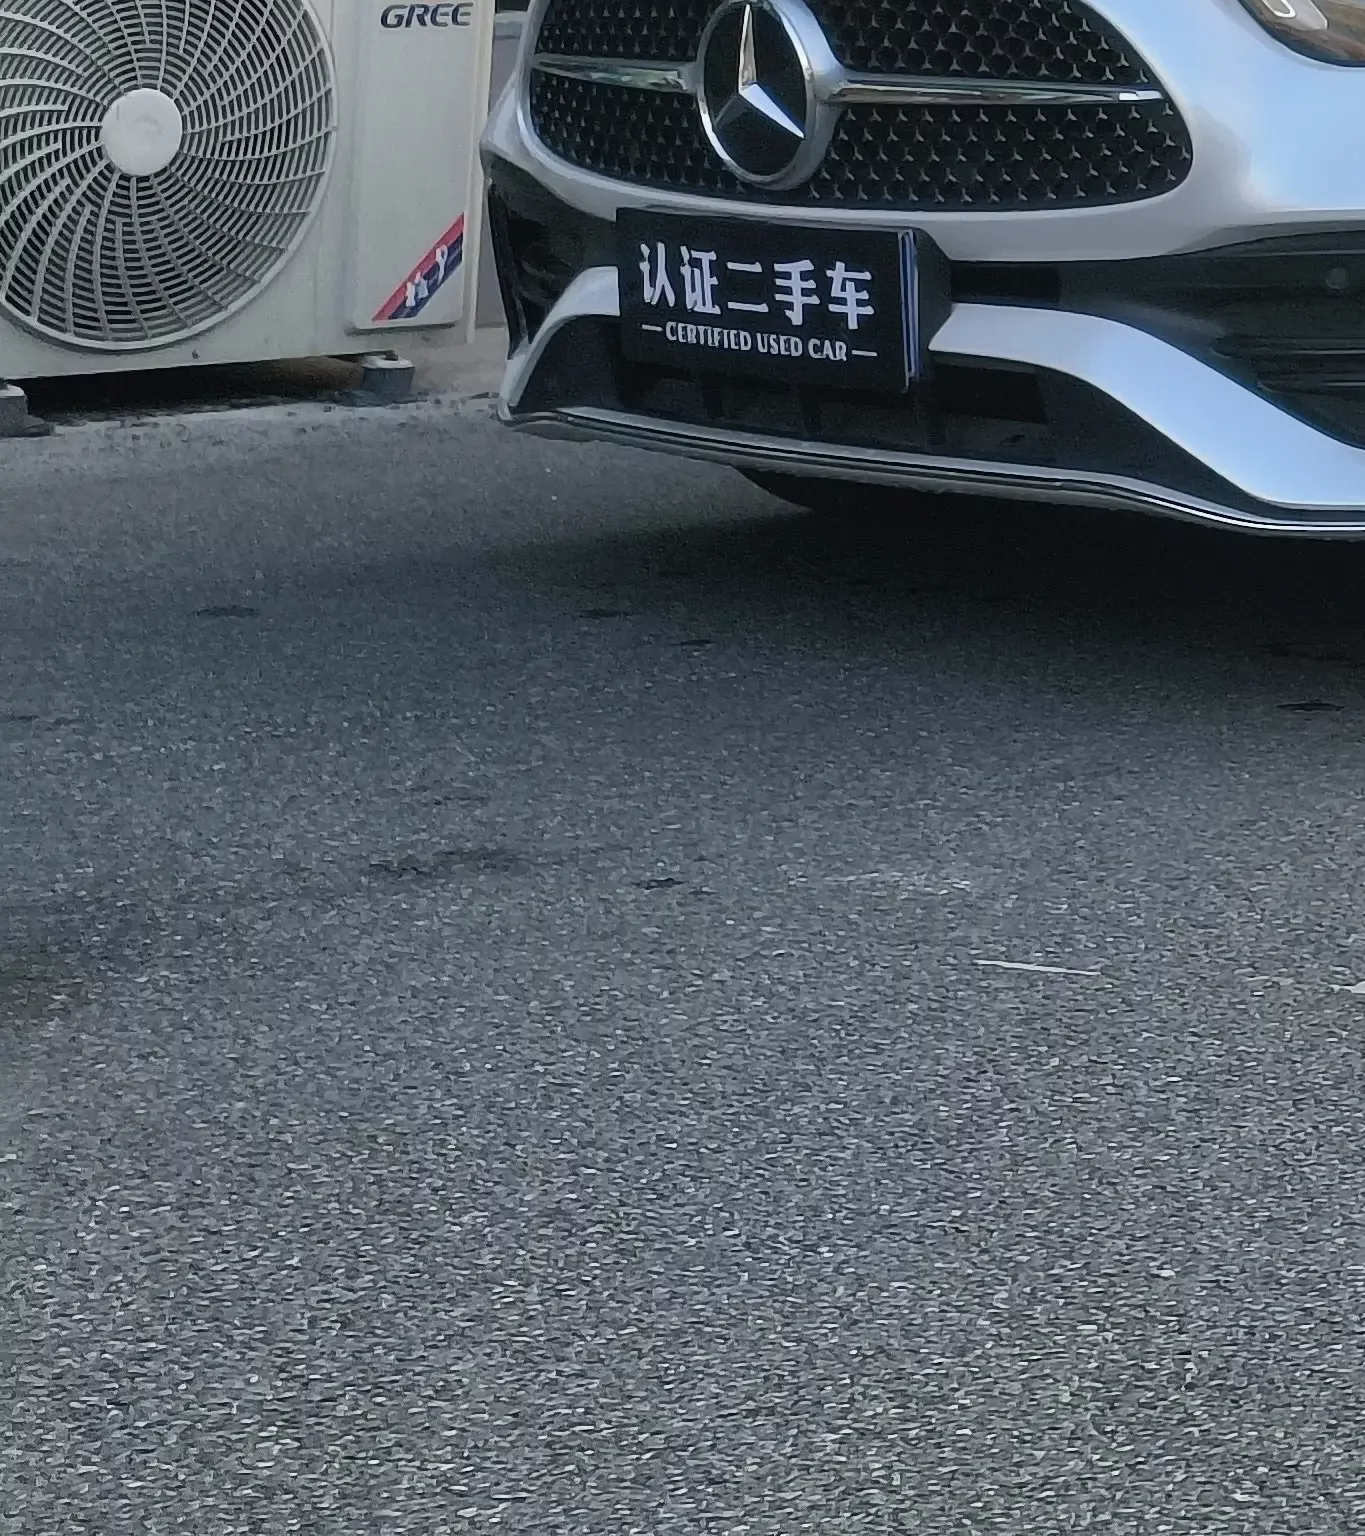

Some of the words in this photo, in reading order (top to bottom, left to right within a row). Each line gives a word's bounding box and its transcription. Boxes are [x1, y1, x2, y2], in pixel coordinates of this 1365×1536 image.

[380, 2, 475, 28] GREE
[638, 241, 875, 330] 认证二手车
[665, 321, 752, 352] CERTIFIED
[757, 332, 803, 357] USED
[807, 338, 848, 362] CAR
